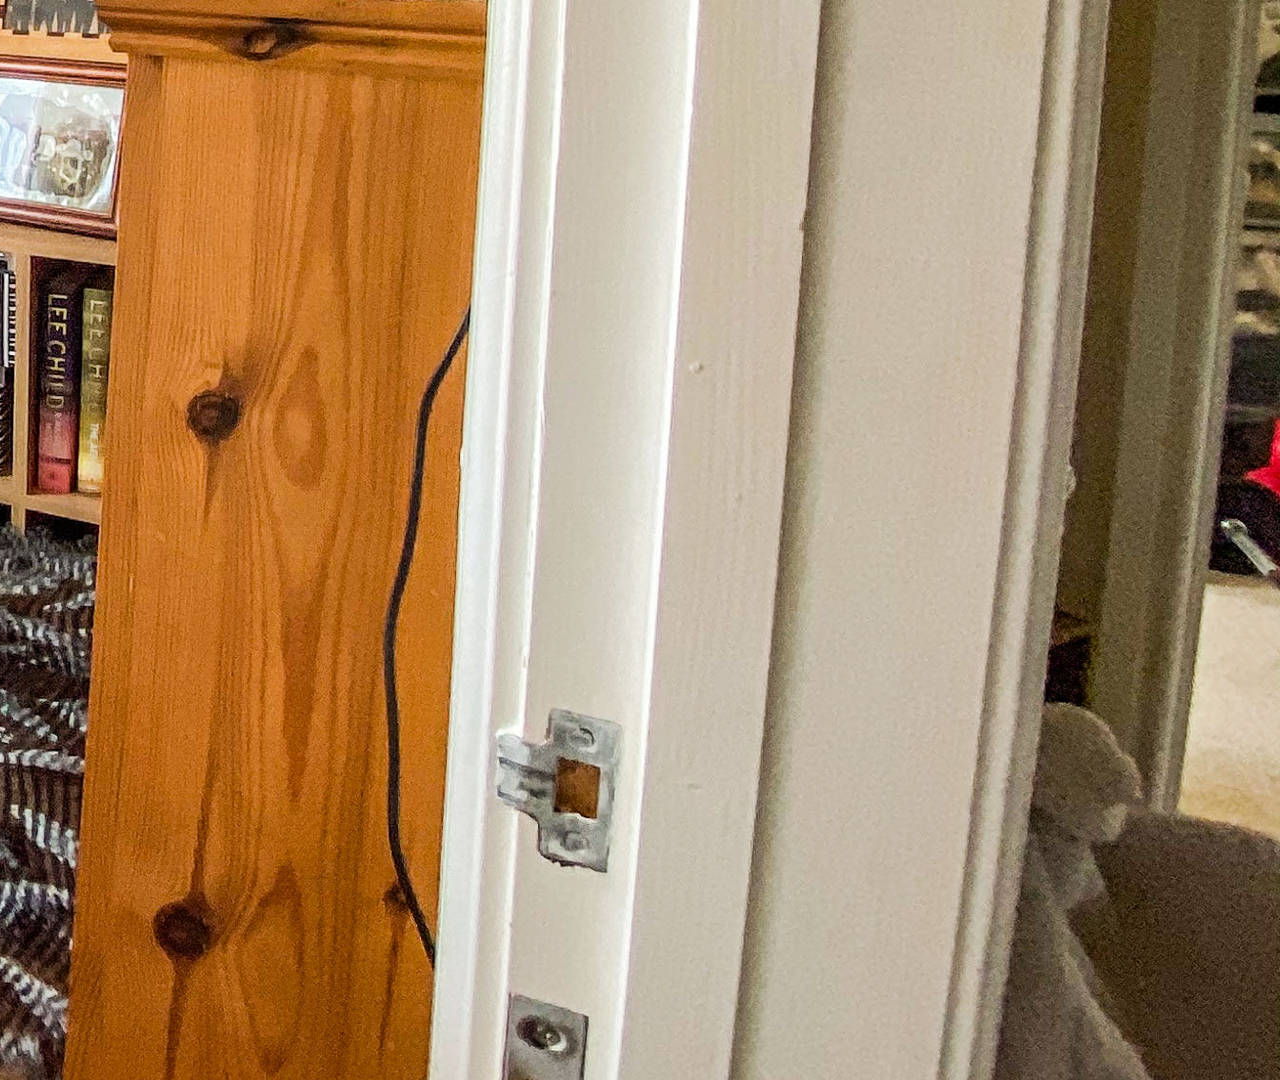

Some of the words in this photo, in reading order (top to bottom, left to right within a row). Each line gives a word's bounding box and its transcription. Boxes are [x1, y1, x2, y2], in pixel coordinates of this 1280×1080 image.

[47, 293, 68, 336] LEE
[89, 299, 108, 341] LEE
[46, 339, 67, 409] CHILD
